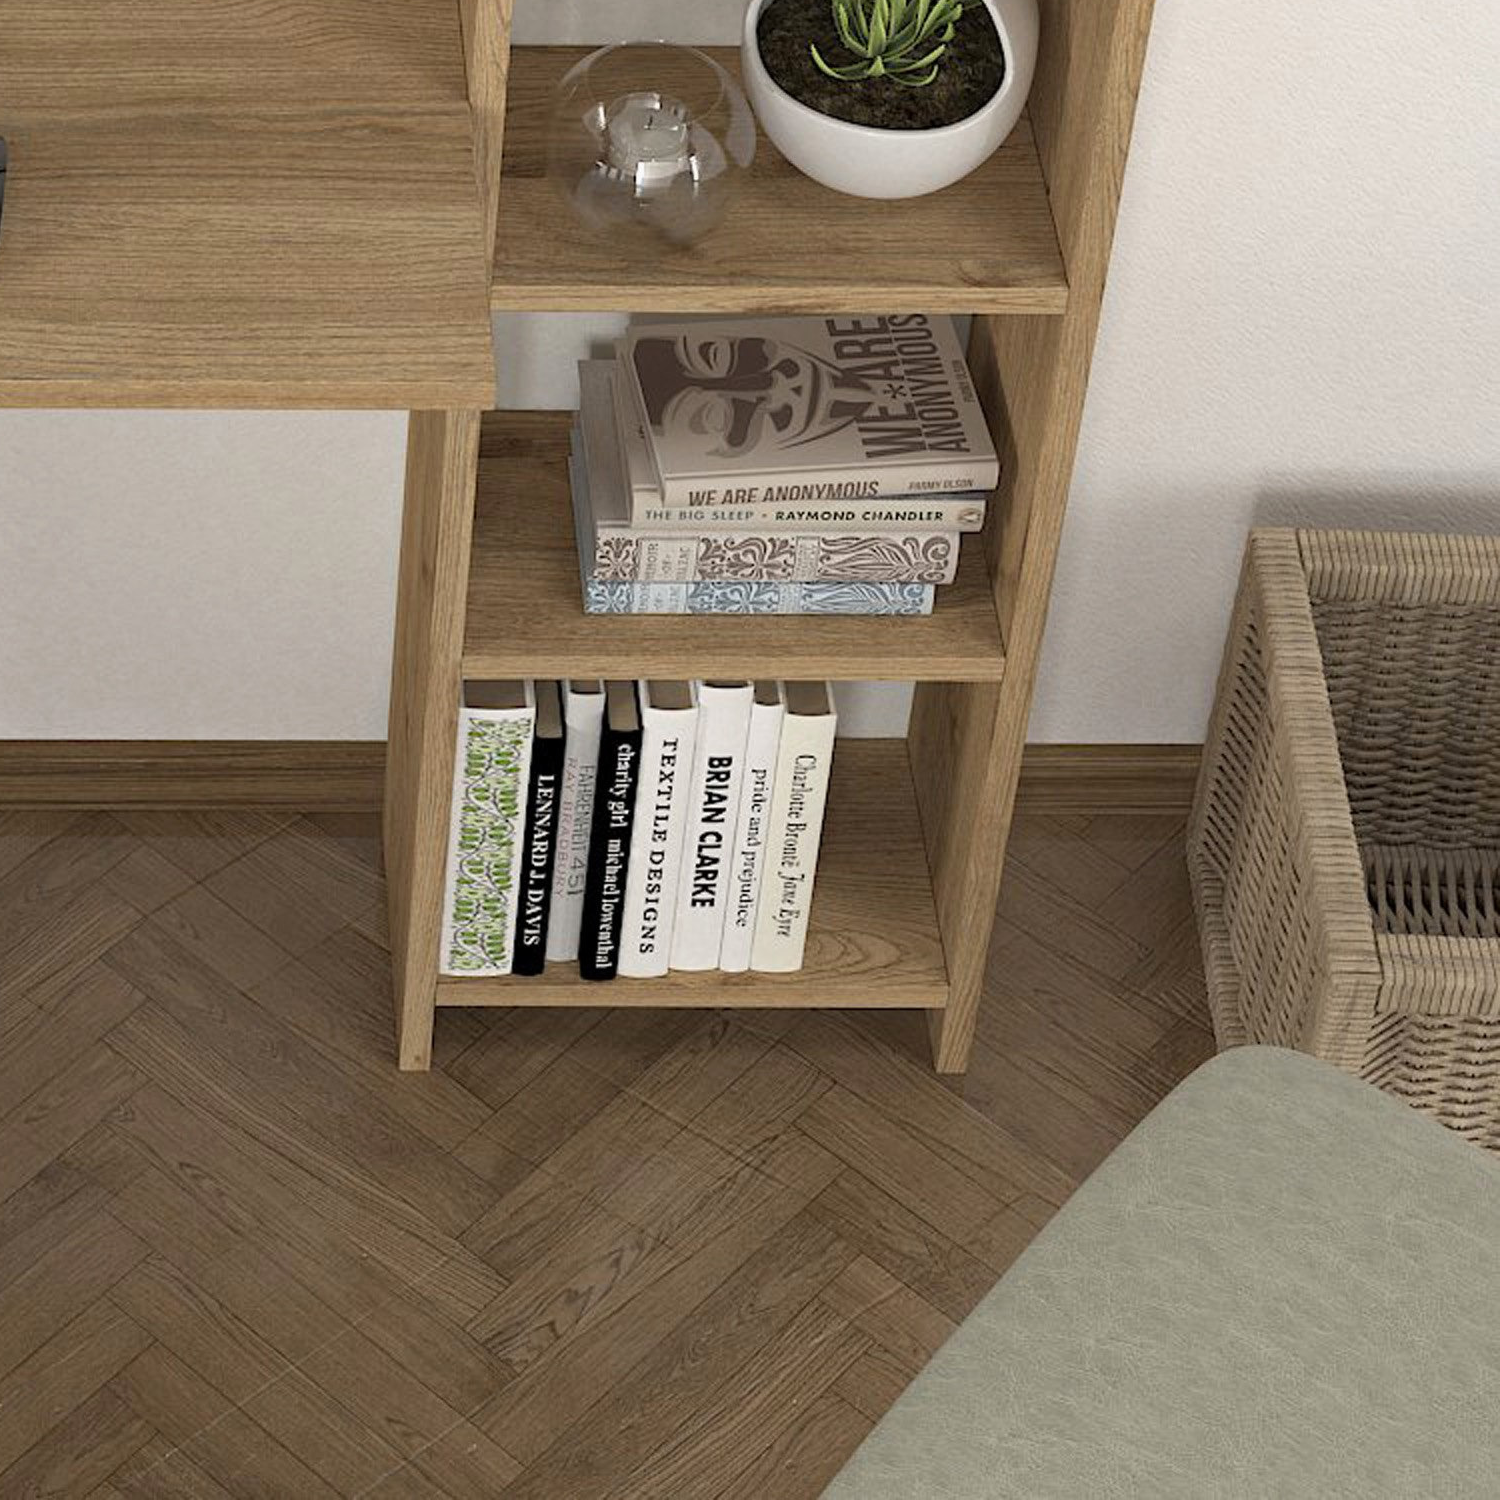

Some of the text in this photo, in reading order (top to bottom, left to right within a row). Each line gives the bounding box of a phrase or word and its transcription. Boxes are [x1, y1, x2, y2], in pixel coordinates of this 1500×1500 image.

[825, 315, 928, 458] WE ARE
[888, 313, 971, 453] ANONYMOUS
[645, 509, 944, 521] THE BIG SLEEP RAYMOND CHANDLER
[688, 480, 880, 507] WE ARE ANONYMOUS
[607, 743, 636, 828] charity girl
[639, 737, 679, 954] TEXTILE DESIGNS
[690, 755, 733, 908] BRIAN CLARKE
[735, 768, 770, 929] pride and prejudice
[787, 754, 818, 819] Charlotte
[522, 774, 556, 946] LENNARD J. DAVIS
[595, 838, 625, 969] michael lowenthal
[777, 870, 806, 906] Jane
